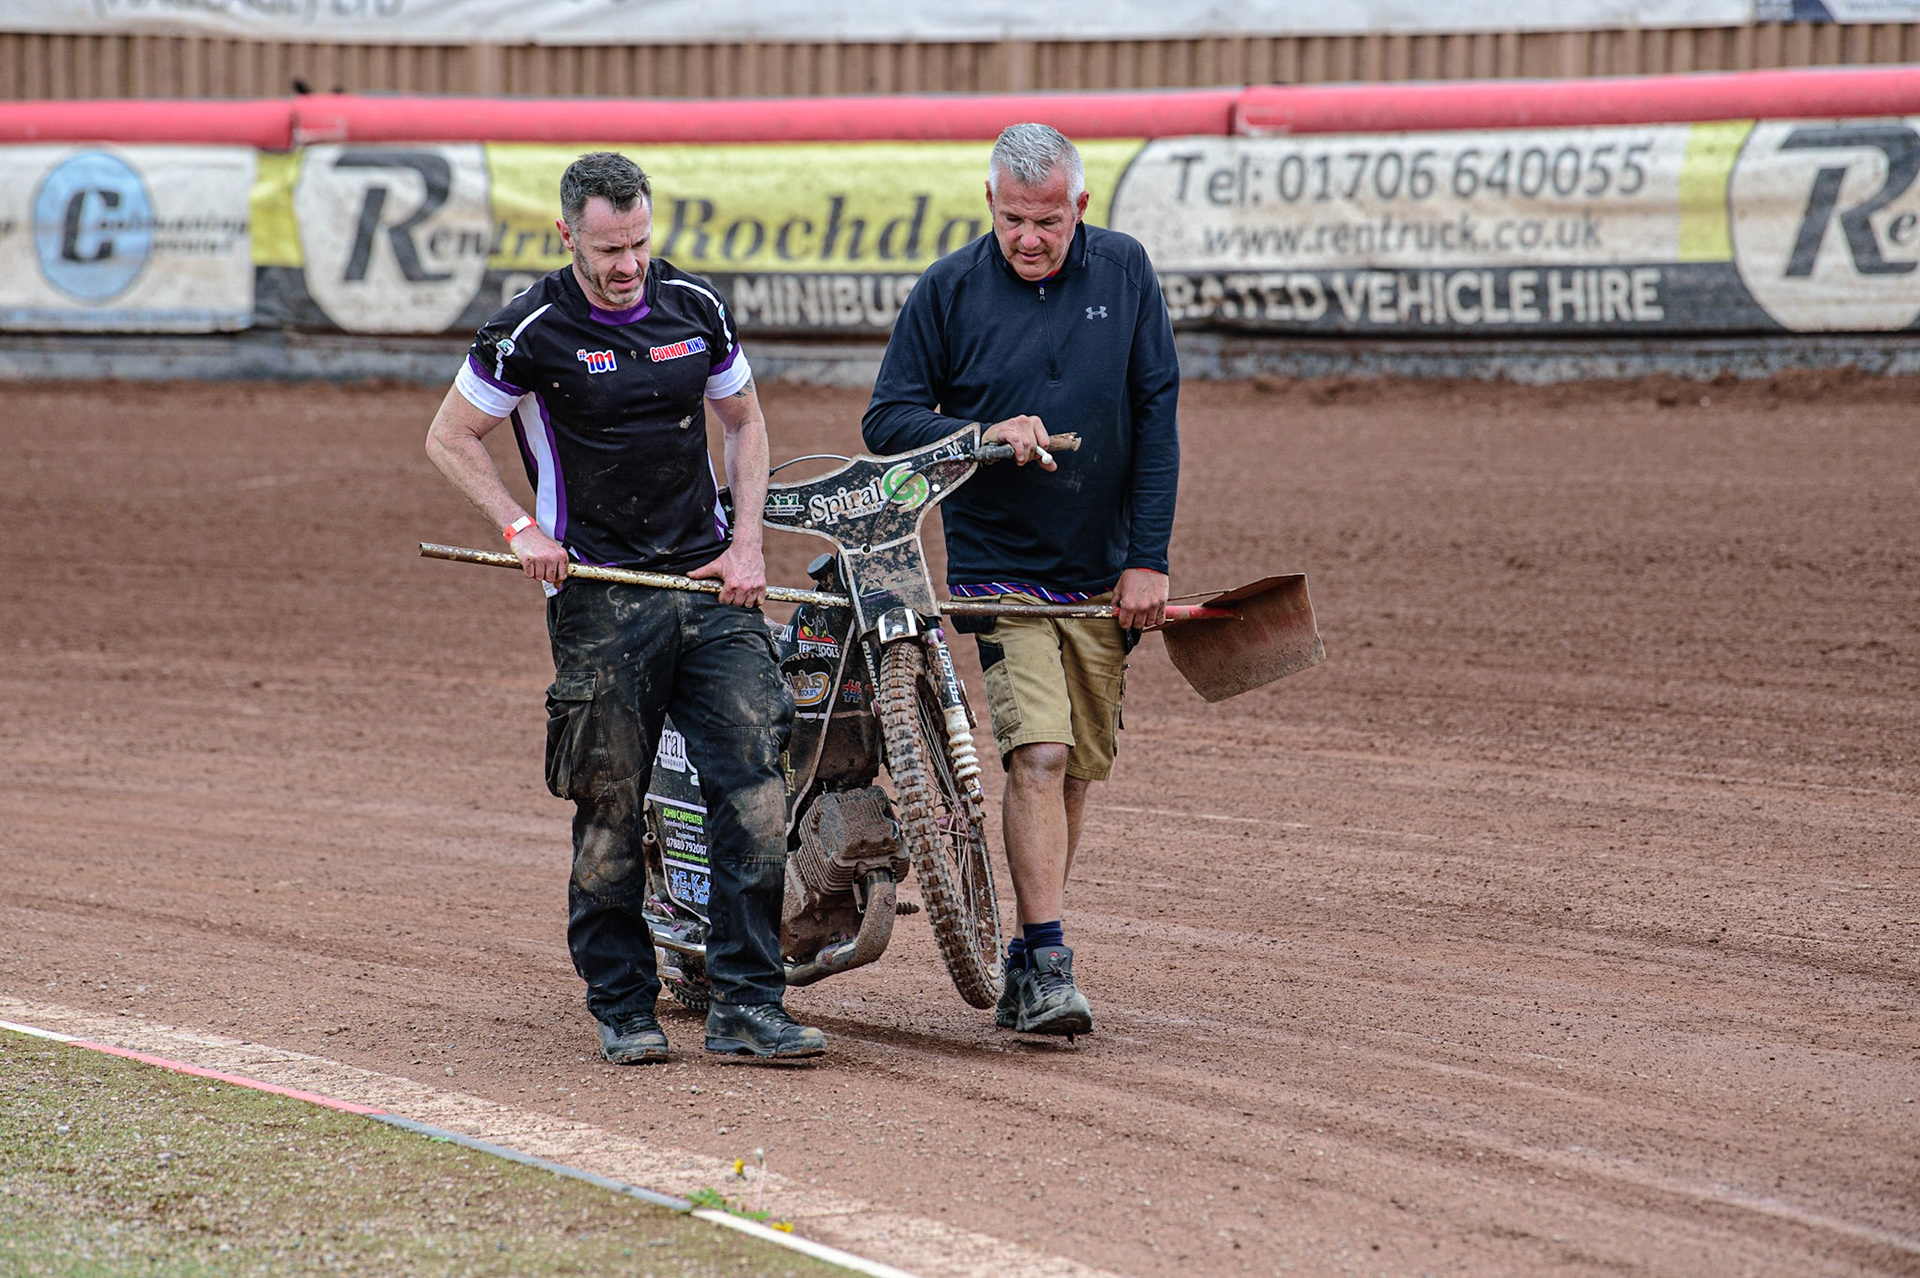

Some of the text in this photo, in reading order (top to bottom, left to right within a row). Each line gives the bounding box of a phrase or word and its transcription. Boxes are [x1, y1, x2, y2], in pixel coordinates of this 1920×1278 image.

[1170, 142, 1653, 206] Tel: 01706 640055
[1203, 211, 1602, 257] www.rentruck.co.uk
[1333, 268, 1542, 326] VEHICLE
[1548, 266, 1666, 324] HIRE
[810, 478, 884, 521] Spiral
[676, 811, 702, 825] CARPENTER
